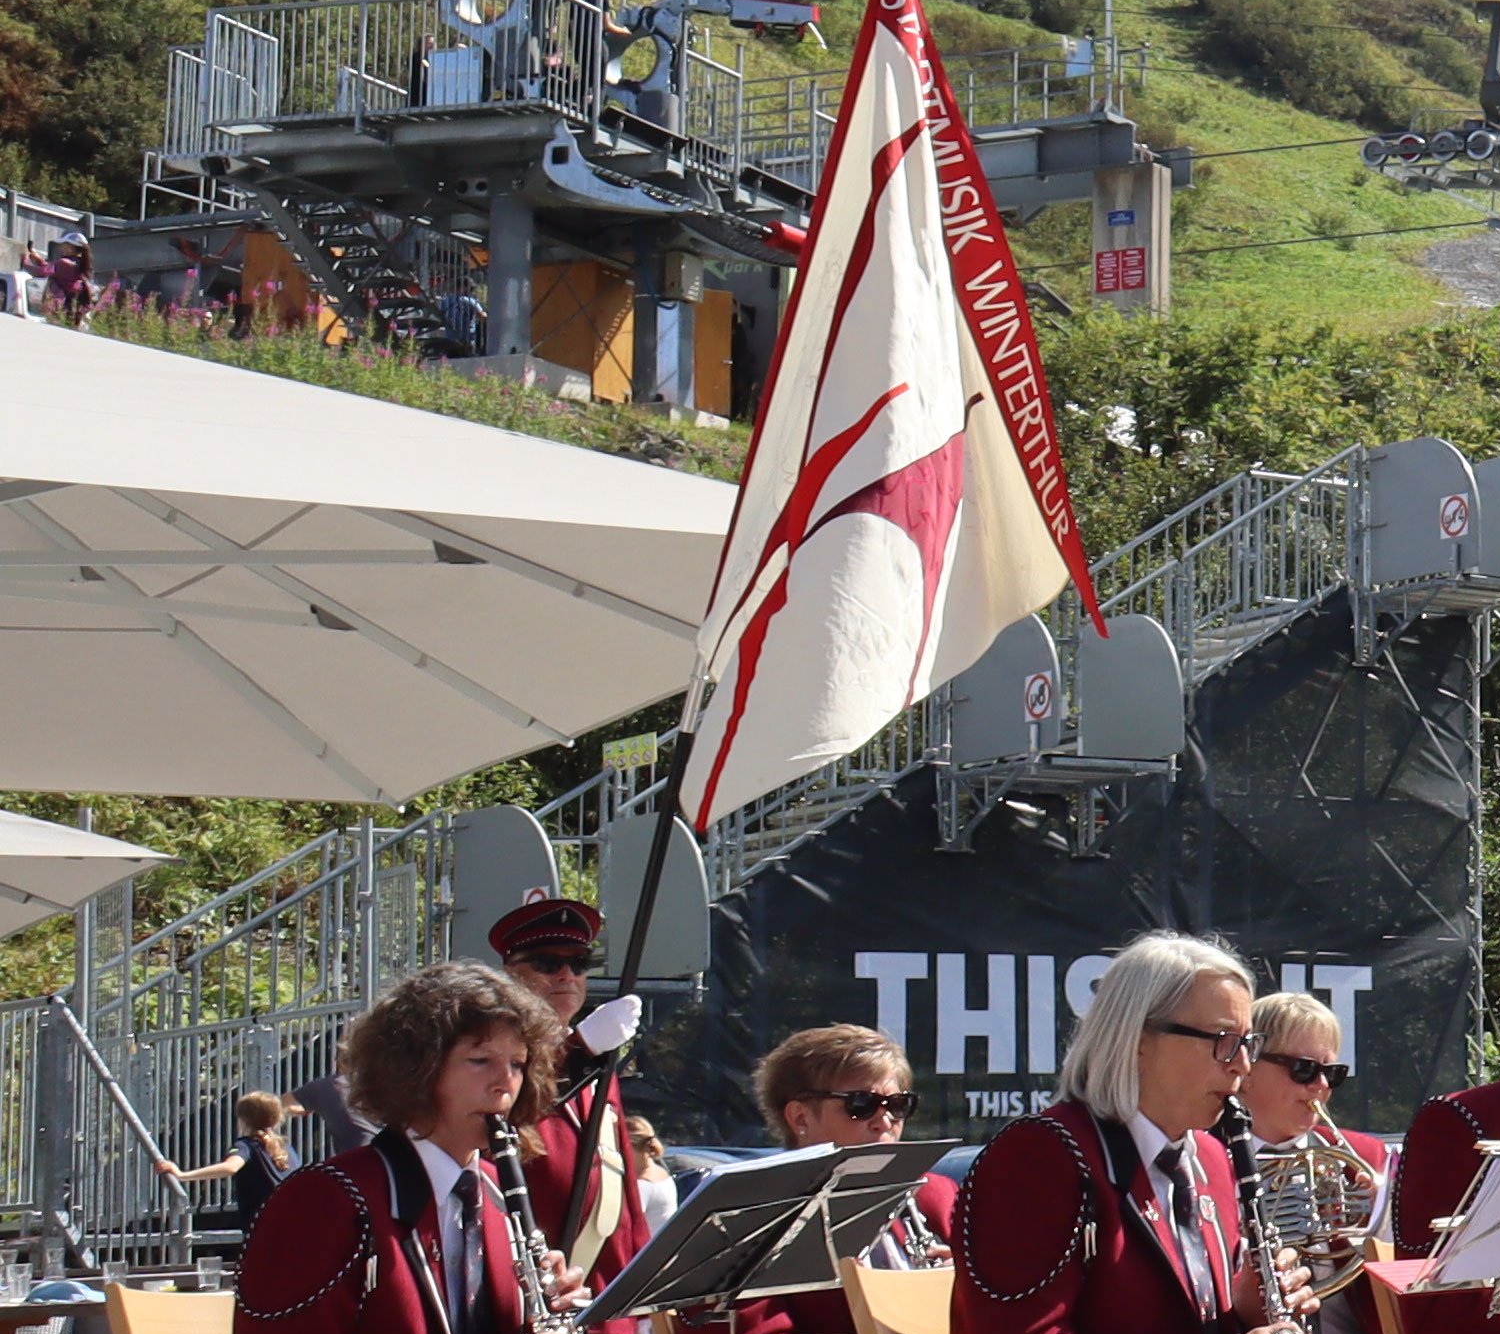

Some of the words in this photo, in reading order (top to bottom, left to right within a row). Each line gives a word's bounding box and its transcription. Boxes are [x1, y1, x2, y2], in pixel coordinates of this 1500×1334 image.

[965, 259, 1070, 546] WINTERTHUR
[1281, 963, 1372, 1077] T
[965, 1090, 1024, 1118] THIS
